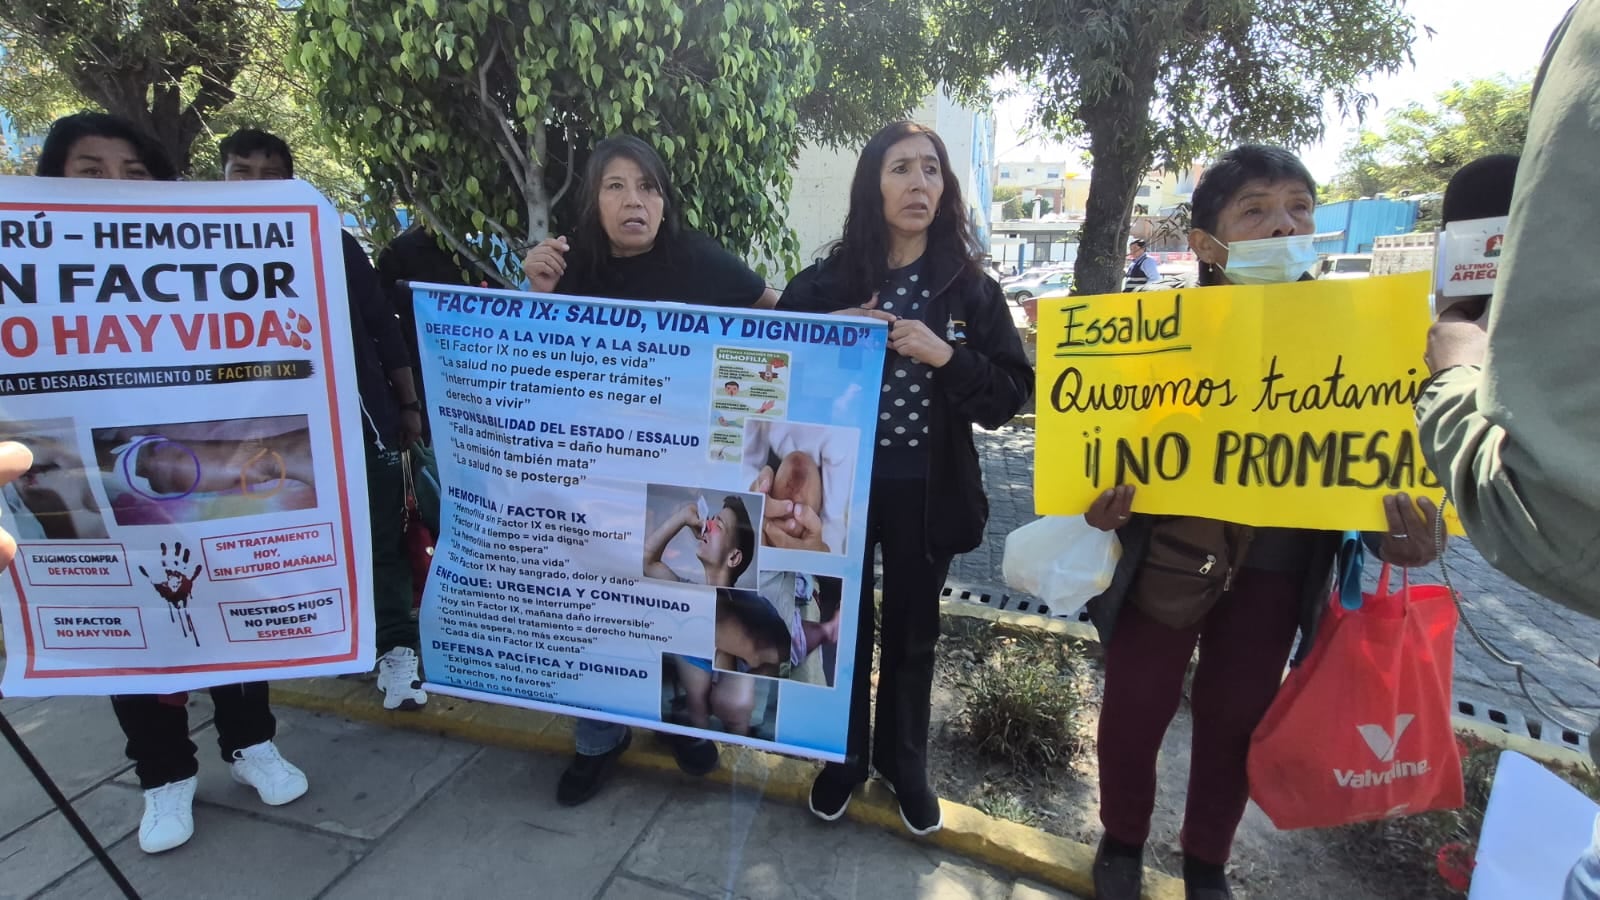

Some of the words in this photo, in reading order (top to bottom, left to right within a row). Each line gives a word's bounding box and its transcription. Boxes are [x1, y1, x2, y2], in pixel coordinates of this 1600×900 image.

[1, 212, 52, 249] RÚ
[0, 264, 38, 303] N
[58, 262, 299, 303] FACTOR
[428, 291, 524, 318] "FACTOR
[656, 311, 709, 334] VIDA
[719, 317, 735, 336] Y
[1056, 294, 1181, 348] Essalud
[1, 317, 38, 358] O
[52, 314, 162, 355] HAY
[170, 310, 291, 351] VIDA
[426, 322, 493, 339] DERECHO
[499, 330, 508, 340] A
[514, 331, 533, 343] LA
[539, 332, 575, 346] VIDA
[580, 337, 591, 347] Y
[596, 338, 606, 348] A
[612, 340, 632, 351] LA
[637, 342, 690, 357] SALUD
[453, 341, 492, 354] Factor
[496, 344, 508, 355] IX
[513, 348, 529, 358] no
[532, 349, 547, 359] es
[551, 351, 567, 361] un
[602, 356, 617, 365] es
[719, 354, 767, 362] HEMOFILIA
[20, 378, 37, 391] DE
[41, 370, 191, 389] DESABASTECIMIENTO
[196, 369, 212, 382] DE
[218, 365, 272, 380] FACTOR
[455, 358, 487, 370] salud
[491, 362, 507, 372] no
[511, 363, 551, 376] puede
[555, 369, 604, 382] esperar
[446, 390, 482, 405] derecho
[485, 397, 491, 405] a
[510, 381, 585, 397] tratamiento
[589, 390, 603, 399] es
[608, 392, 645, 404] negar
[650, 394, 661, 405] el
[1050, 367, 1237, 414] Queremos
[439, 406, 536, 432] RESPONSABILIDAD
[540, 423, 565, 434] DEL
[570, 425, 624, 440] ESTADO
[636, 431, 699, 447] ESSALUD
[476, 428, 554, 449] administrativa
[570, 440, 602, 453] daño
[466, 441, 501, 458] omisión
[504, 450, 552, 465] también
[469, 457, 490, 472] salud
[492, 465, 502, 476] no
[505, 468, 517, 478] se
[448, 486, 497, 513] HEMOFILIA
[507, 505, 566, 520] FACTOR
[572, 512, 586, 524] IX
[497, 518, 528, 529] Factor
[531, 520, 541, 529] IX
[559, 524, 590, 536] riesgo
[532, 533, 554, 542] vida
[216, 540, 235, 551] SIN
[238, 529, 319, 548] TRATAMIENTO
[494, 542, 505, 550] no
[32, 555, 77, 564] EXIGIMOS
[78, 554, 119, 563] COMPRA
[214, 567, 232, 577] SIN
[234, 561, 280, 575] FUTURO
[282, 553, 333, 568] MAÑANA
[522, 557, 540, 565] una
[487, 561, 496, 572] IX
[499, 563, 516, 575] hay
[572, 571, 599, 582] dolor
[601, 575, 607, 584] y
[230, 603, 295, 617] NUESTROS
[298, 597, 333, 610] HIJOS
[450, 586, 505, 601] tratamiento
[508, 594, 519, 602] no
[522, 596, 533, 605] se
[497, 580, 570, 597] URGENCIA
[576, 589, 586, 598] Y
[591, 589, 690, 613] CONTINUIDAD
[54, 618, 72, 626] SIN
[75, 617, 121, 626] FACTOR
[245, 618, 261, 628] NO
[264, 613, 317, 626] PUEDEN
[461, 598, 475, 607] sin
[477, 601, 507, 612] Factor
[510, 605, 522, 615] IX,
[525, 608, 563, 620] mañana
[566, 610, 590, 622] daño
[57, 629, 74, 638] NO
[76, 629, 99, 637] HAY
[102, 628, 131, 638] VIDA
[257, 626, 312, 638] ESPERAR
[508, 614, 516, 624] del
[518, 616, 574, 632] tratamiento
[585, 625, 626, 637] derecho
[471, 629, 485, 640] día
[487, 632, 501, 643] sin
[504, 636, 533, 648] Factor
[535, 641, 544, 650] IX
[432, 640, 493, 658] DEFENSA
[498, 650, 560, 668] PACÍFICA
[565, 660, 575, 669] Y
[579, 662, 648, 679] DIGNIDAD
[495, 660, 523, 672] salud,
[526, 666, 538, 674] no
[501, 674, 512, 682] no
